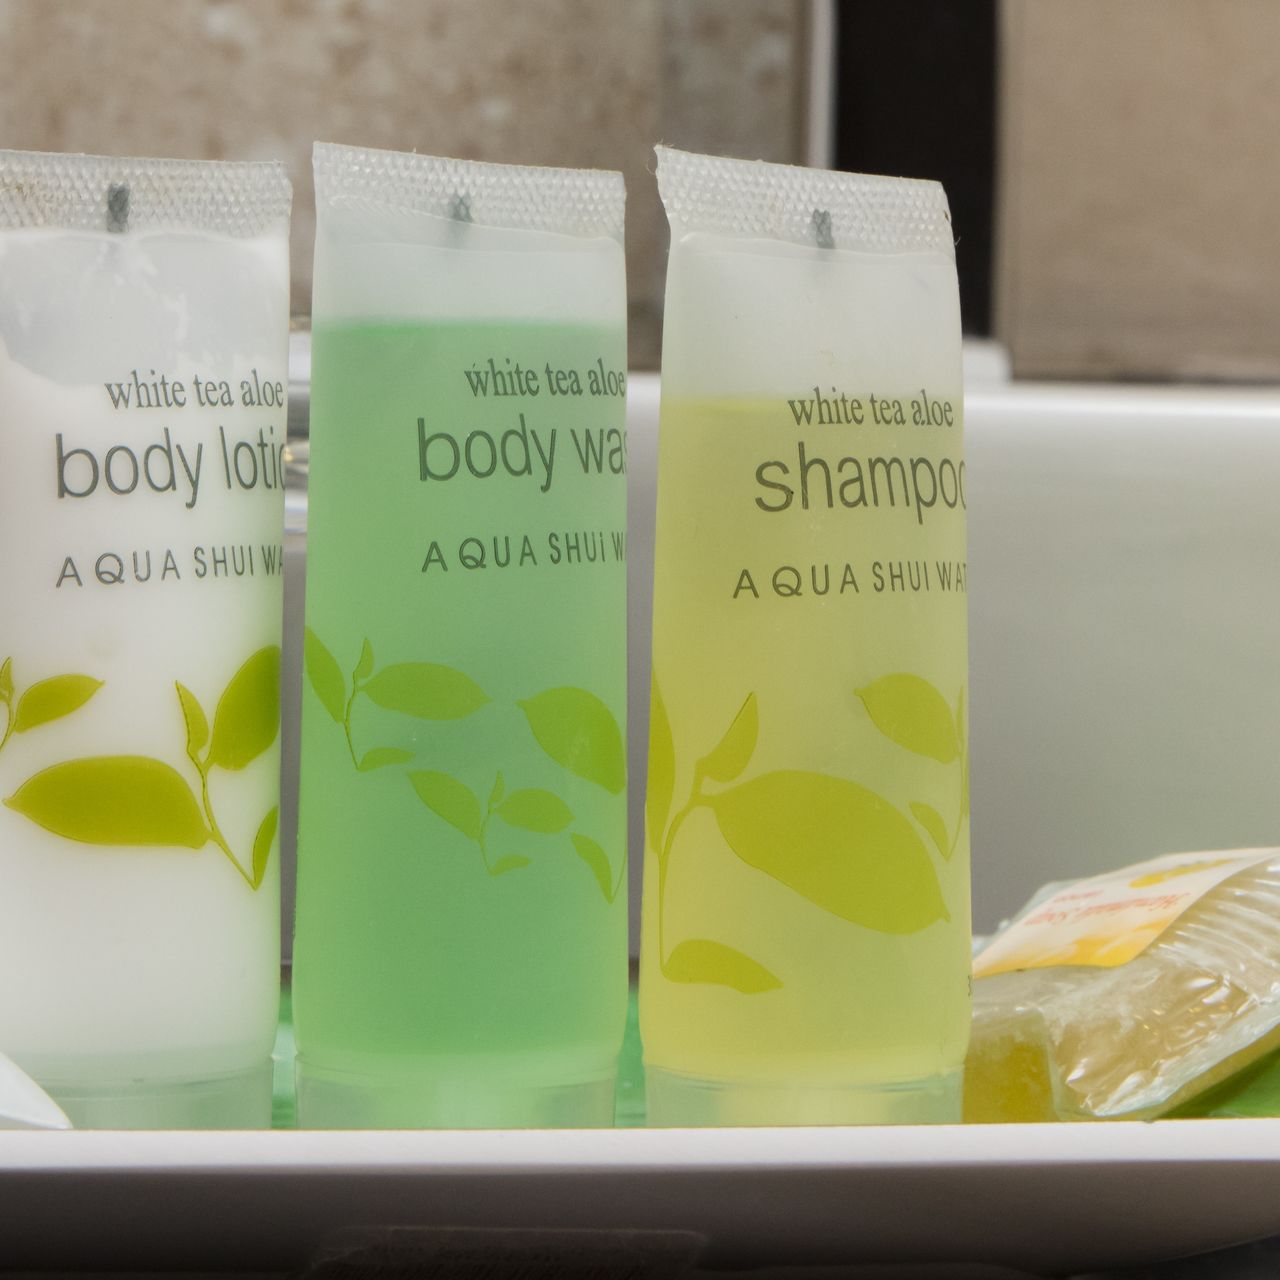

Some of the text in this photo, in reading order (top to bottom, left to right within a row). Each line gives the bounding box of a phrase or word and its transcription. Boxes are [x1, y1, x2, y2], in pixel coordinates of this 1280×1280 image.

[104, 368, 284, 410] white tea aloe
[464, 358, 625, 398] white tea aloe
[787, 386, 954, 427] white tea aloe
[55, 426, 203, 509] body
[417, 413, 557, 493] body
[55, 548, 181, 588] AQUA
[193, 545, 254, 579] SHUI
[421, 535, 538, 573] AQUA
[548, 531, 606, 565] SHUI
[732, 563, 860, 599] AQUA
[872, 561, 930, 593] SHUI
